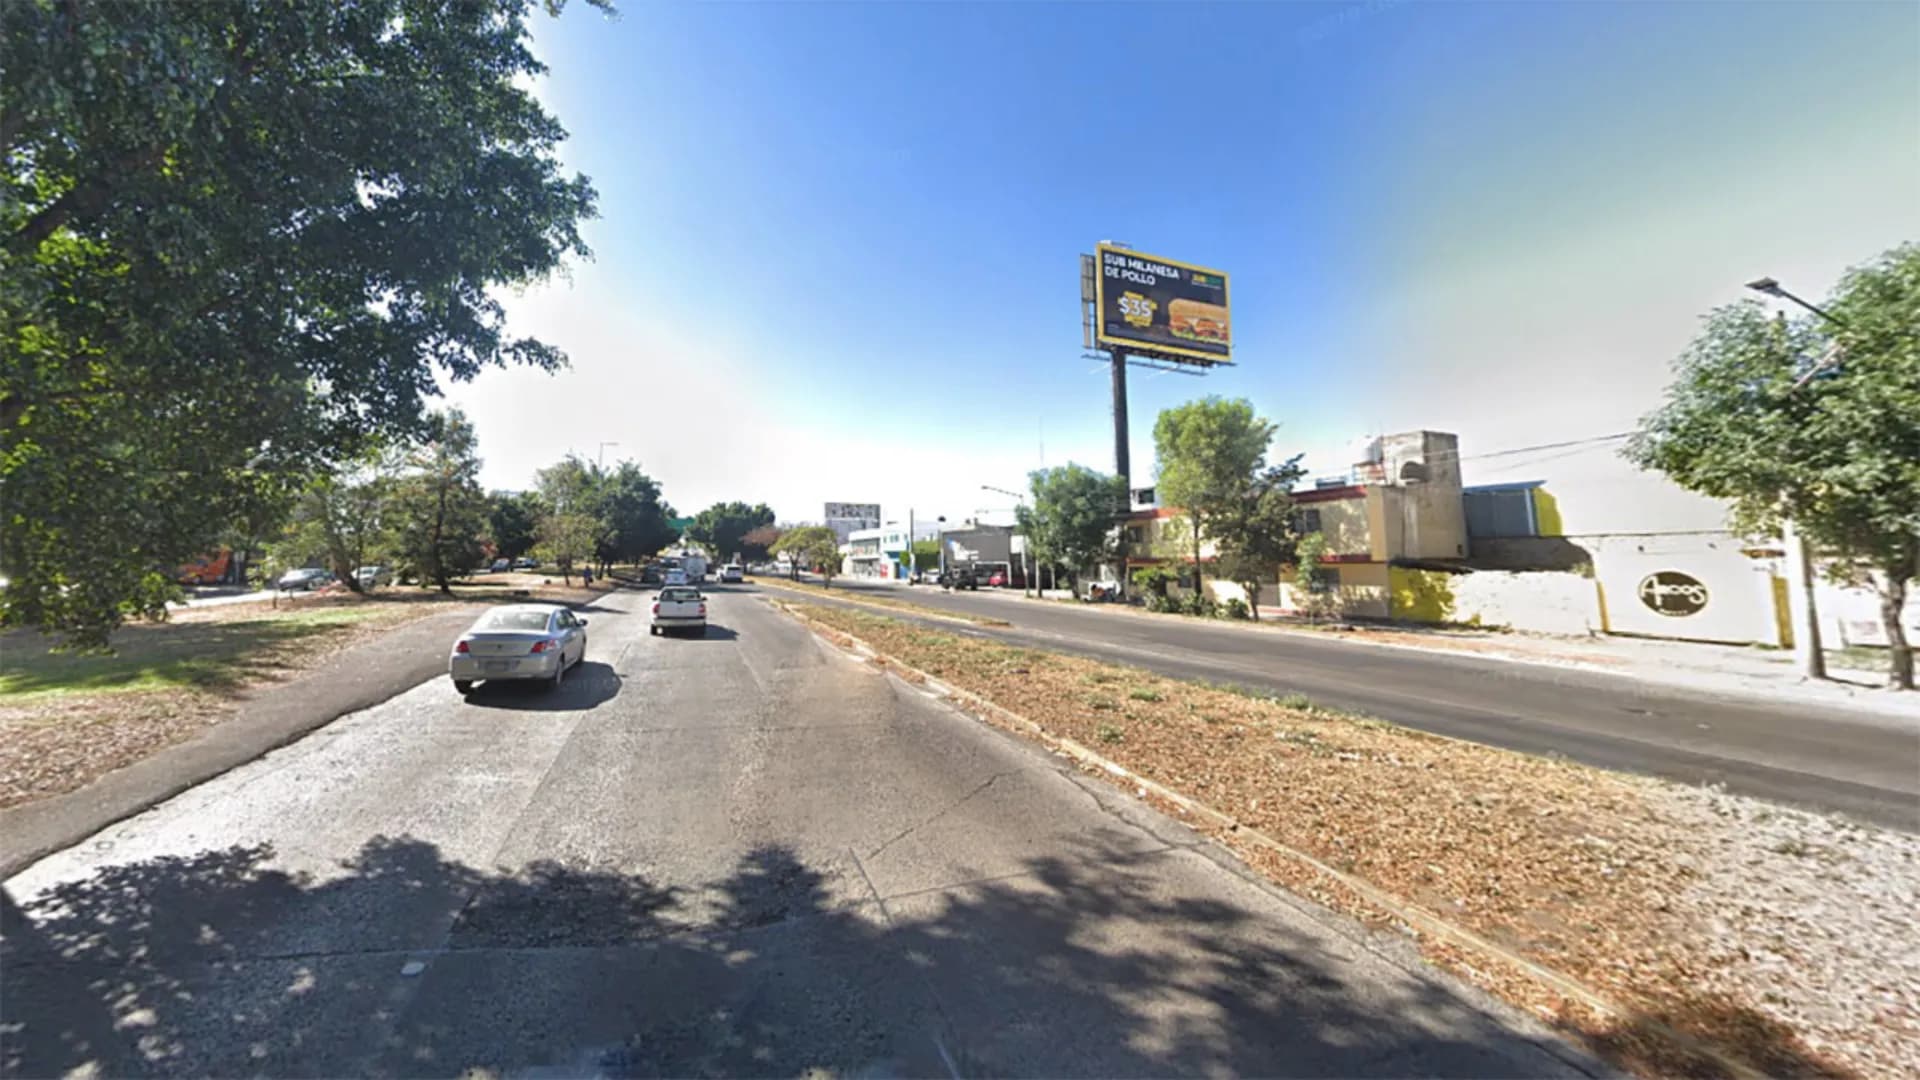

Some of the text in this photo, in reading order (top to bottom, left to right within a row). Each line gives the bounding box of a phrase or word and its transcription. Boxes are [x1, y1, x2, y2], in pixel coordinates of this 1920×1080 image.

[1104, 253, 1126, 267] SUB
[1128, 258, 1180, 280] MILANESA
[1104, 266, 1156, 286] DE POLLO
[1119, 296, 1152, 318] $35
